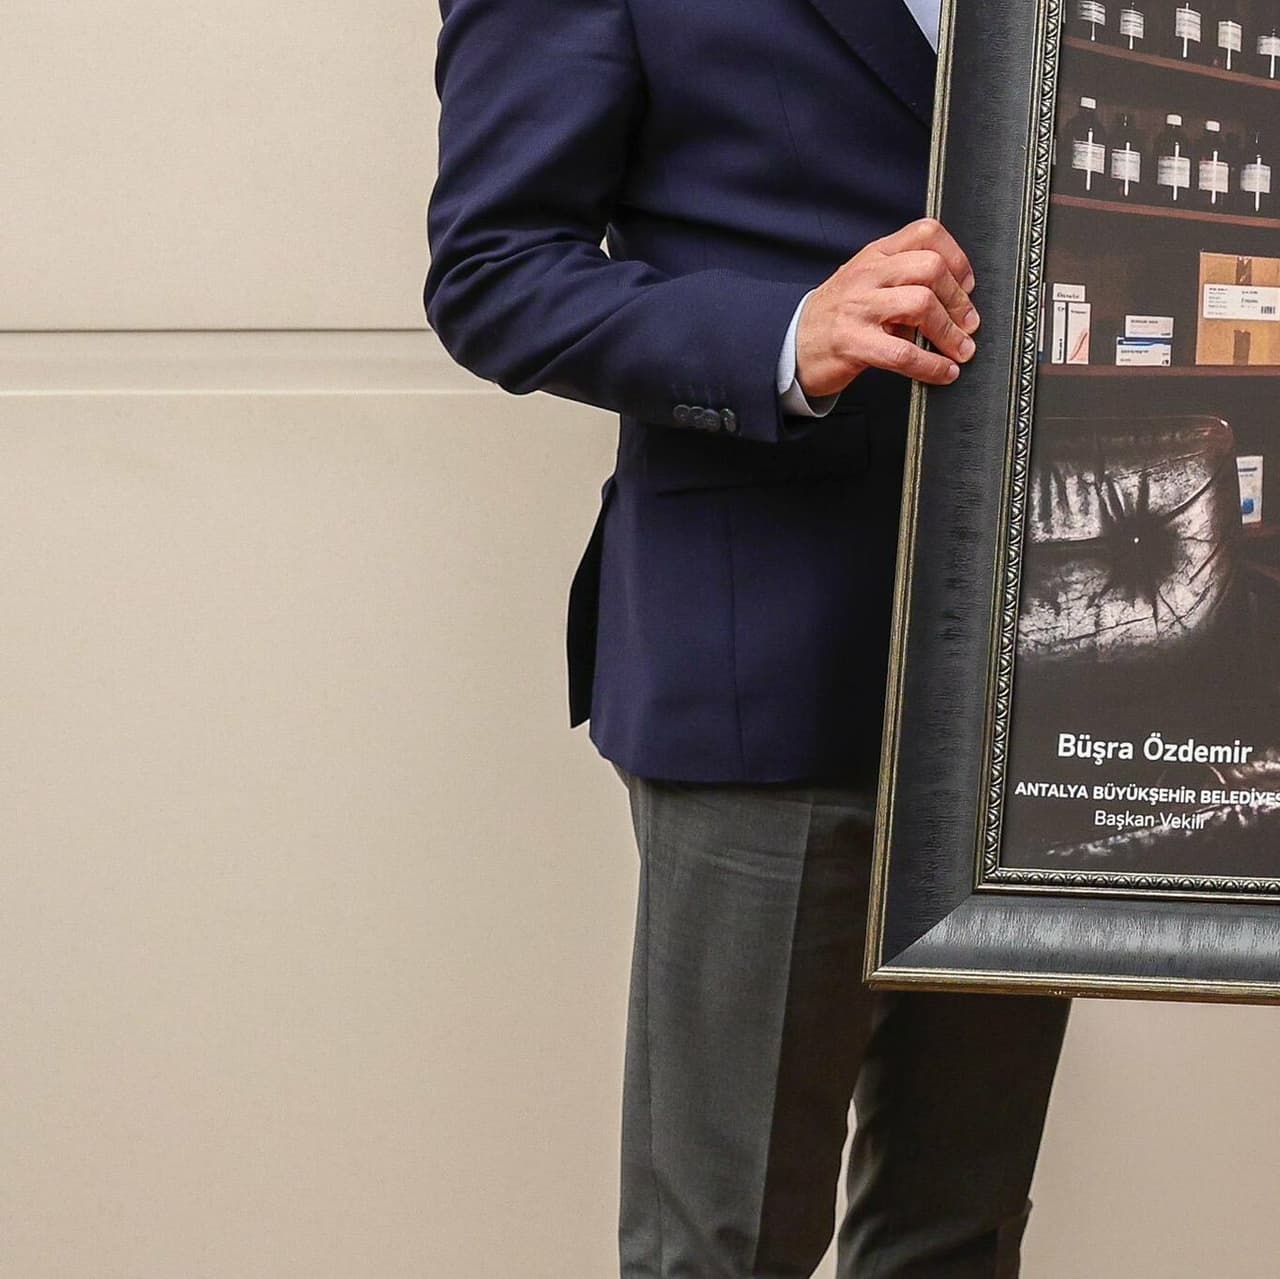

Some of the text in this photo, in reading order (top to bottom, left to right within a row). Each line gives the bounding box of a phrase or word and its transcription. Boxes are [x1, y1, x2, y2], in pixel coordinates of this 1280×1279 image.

[1057, 732, 1253, 764] Büşra Özdemir
[1014, 782, 1089, 800] ANTALYA
[1093, 784, 1196, 805] BÜYÜKŞEHİR
[1094, 810, 1206, 830] Başkan Vekili
